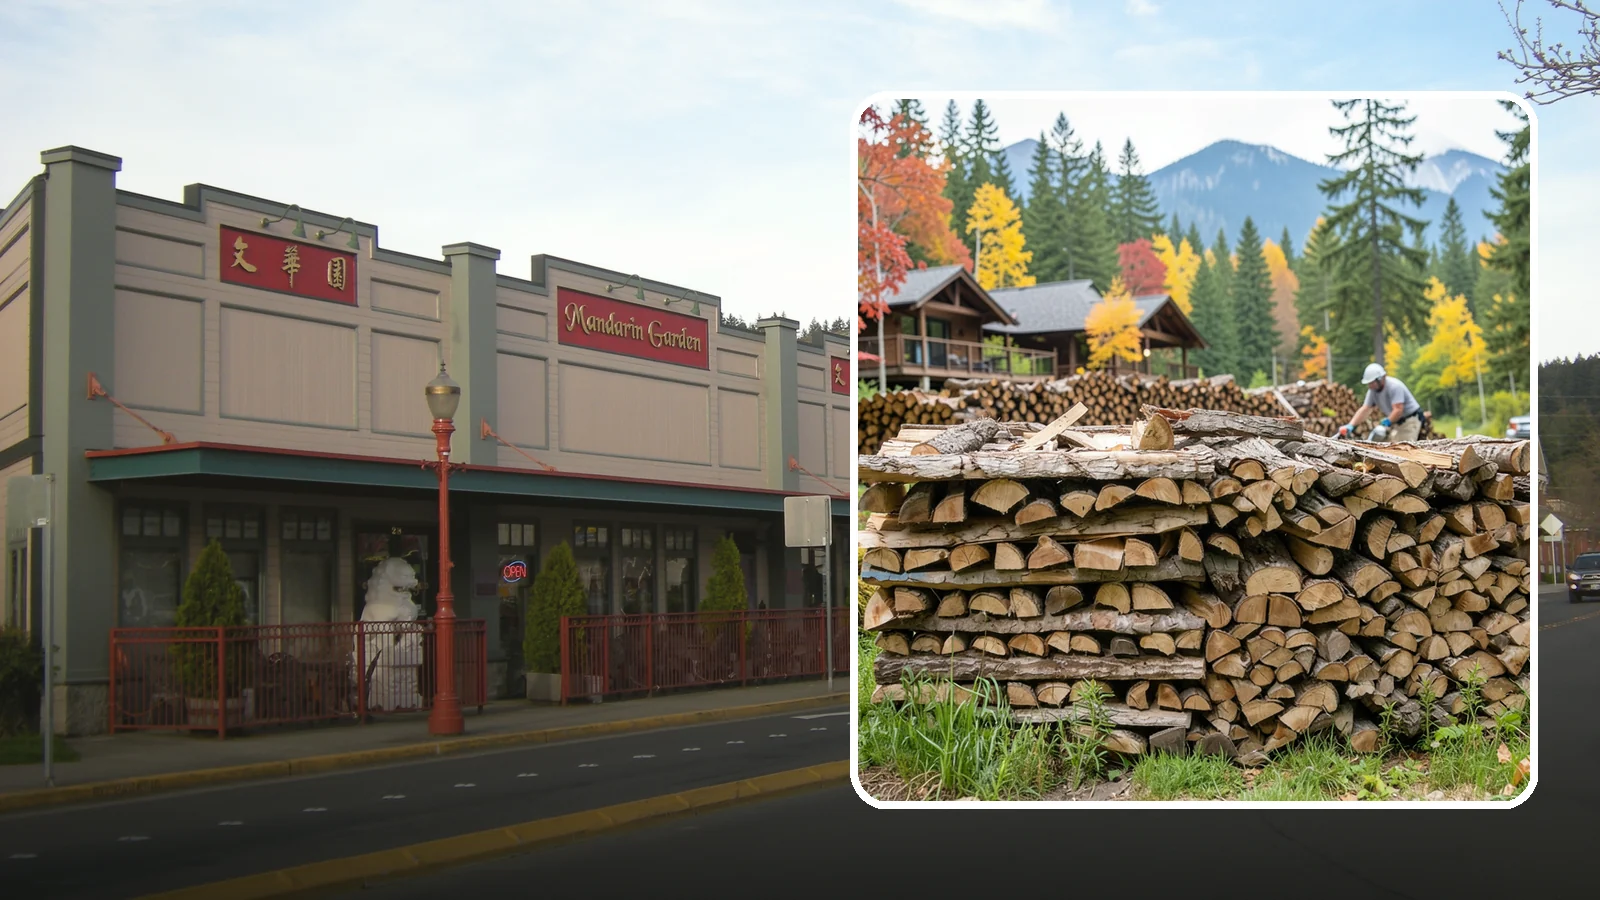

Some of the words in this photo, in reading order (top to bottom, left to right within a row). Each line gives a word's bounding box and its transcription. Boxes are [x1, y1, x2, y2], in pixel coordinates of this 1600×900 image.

[231, 236, 346, 290] 文華園
[565, 302, 644, 341] Mandarin
[648, 320, 701, 352] Garden
[503, 565, 527, 578] OPEN
